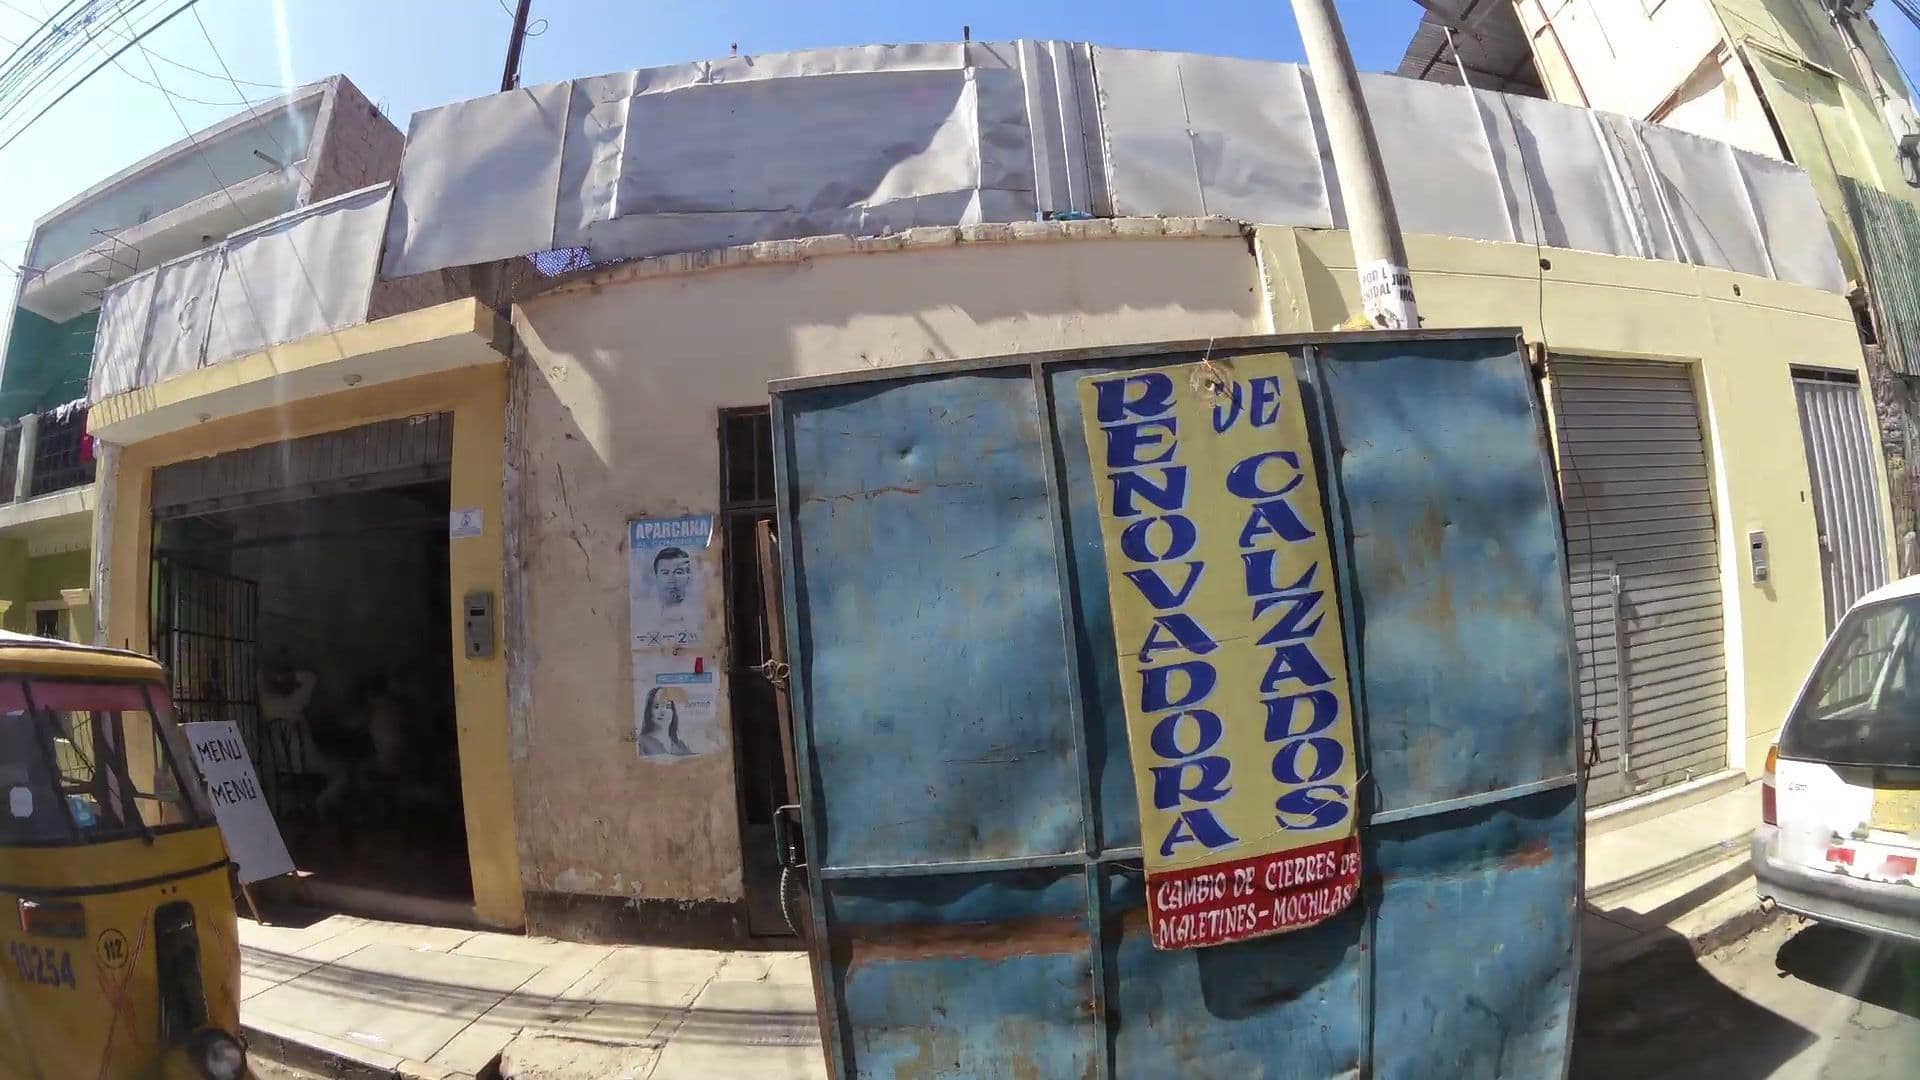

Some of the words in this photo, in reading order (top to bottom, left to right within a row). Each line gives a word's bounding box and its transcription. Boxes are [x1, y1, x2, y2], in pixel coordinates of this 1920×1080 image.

[636, 520, 709, 541] APARCANA
[1092, 373, 1240, 857] RENOVADORA
[1226, 450, 1350, 830] CALZADOS
[1157, 871, 1228, 912] CAMBIO
[1234, 866, 1256, 898] DE
[1264, 851, 1336, 892] CIERRES
[1340, 852, 1359, 876] DE
[1272, 884, 1352, 926] MOCHILAS
[103, 938, 123, 962] 112
